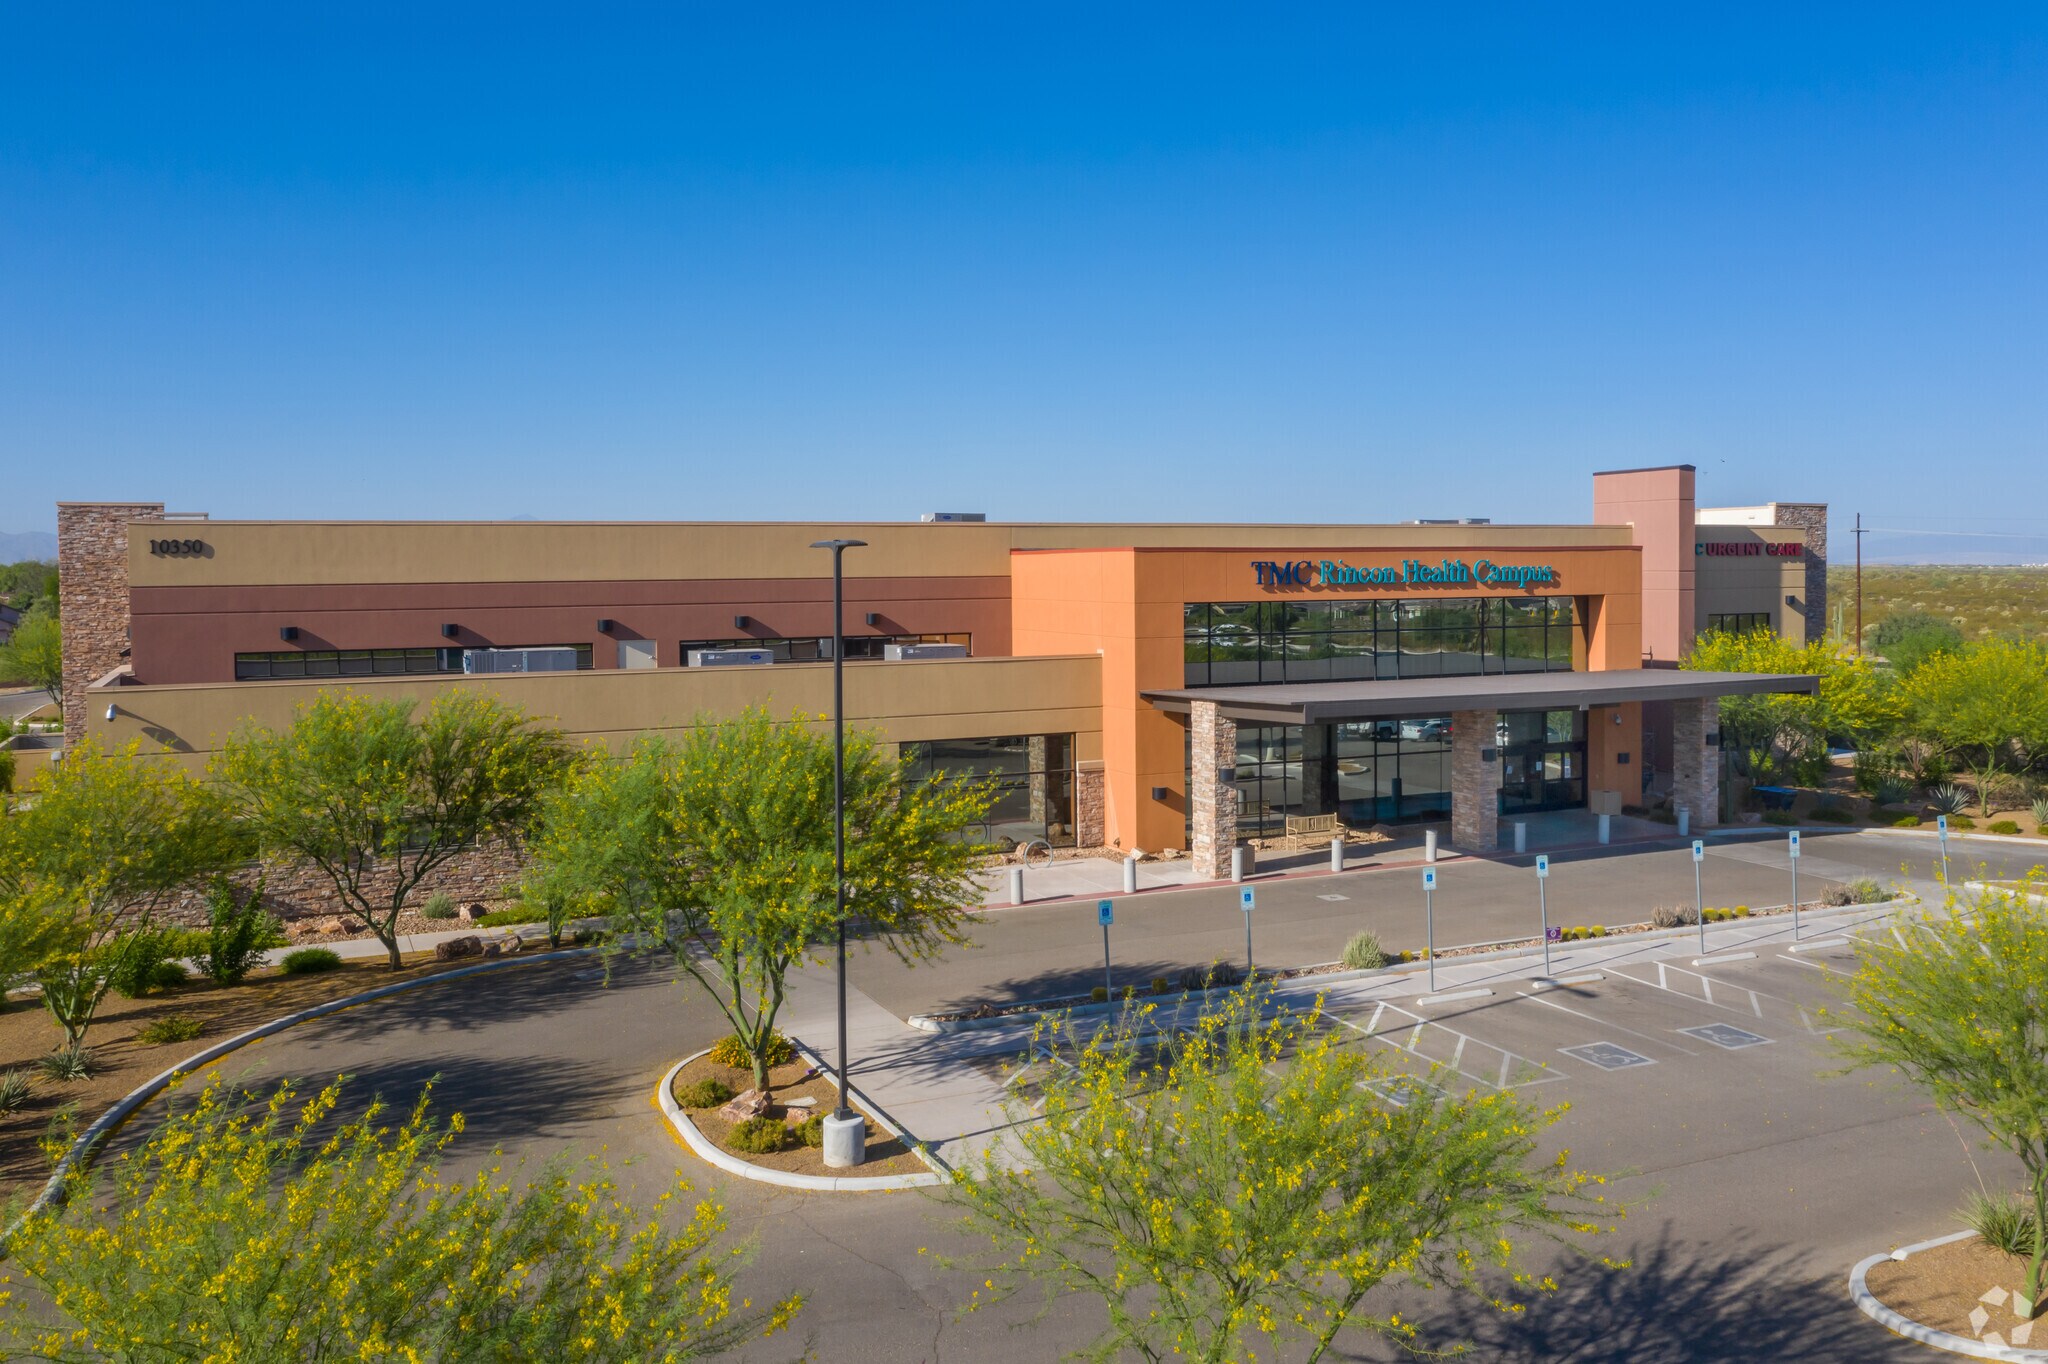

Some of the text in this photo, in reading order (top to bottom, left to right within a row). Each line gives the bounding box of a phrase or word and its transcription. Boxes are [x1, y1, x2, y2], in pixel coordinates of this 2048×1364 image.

[150, 539, 203, 554] 10350
[1706, 543, 1764, 557] URGENT
[1766, 543, 1803, 557] CARE
[1251, 559, 1553, 588] TMC Rincon Health Campus
